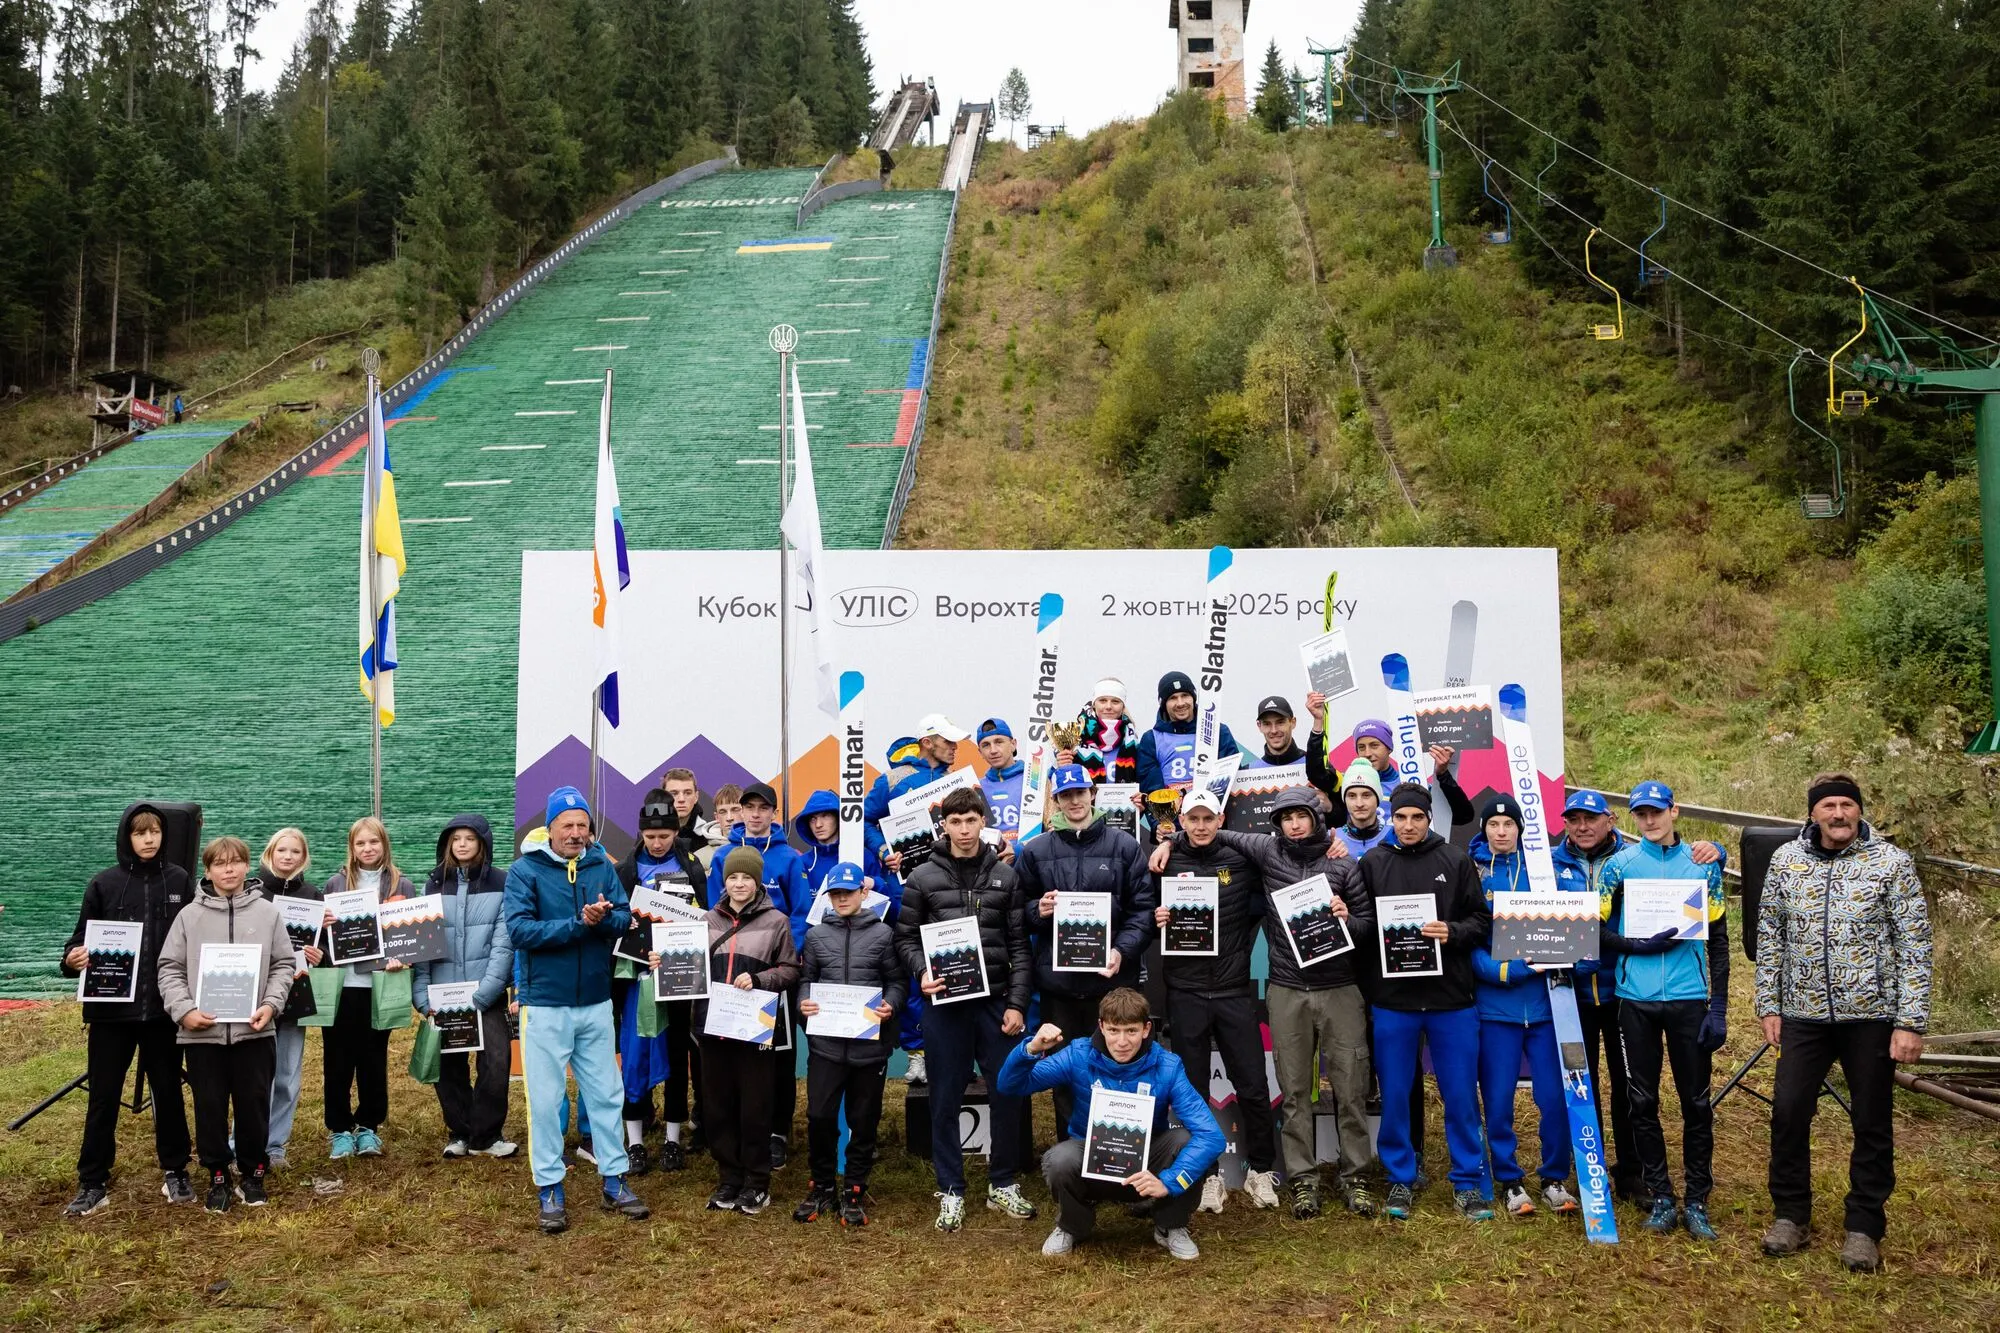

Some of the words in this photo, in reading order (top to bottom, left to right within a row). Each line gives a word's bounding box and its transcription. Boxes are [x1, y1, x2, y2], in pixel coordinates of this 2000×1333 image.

[698, 595, 777, 623] Кубок
[840, 594, 908, 618] УЛІС
[1101, 594, 1116, 617] 2
[1227, 592, 1289, 616] 2025
[1200, 598, 1228, 693] Slatnar
[1028, 647, 1058, 743] Slatnar
[1463, 691, 1477, 699] МРІЇ
[1433, 725, 1448, 733] 000
[1449, 725, 1462, 733] грн
[840, 725, 864, 823] Slatnar
[1236, 774, 1275, 784] СЕРТИФІКАТ
[905, 787, 941, 807] СЕРТИФІКАТ
[941, 782, 951, 792] НА
[950, 776, 964, 788] МРІЇ
[1511, 745, 1543, 852] fluege.de
[990, 804, 1019, 827] 36
[1253, 806, 1262, 814] 15
[1290, 887, 1314, 901] ДИПЛОМ
[340, 897, 363, 906] ДИПЛОМ
[1393, 903, 1420, 911] ДИПЛОМ
[1568, 898, 1584, 906] МРІЇ
[380, 908, 404, 917] ИФІКАТ
[415, 902, 429, 910] МРІЇ
[649, 900, 689, 918] СЕРТИФІКАТ
[689, 912, 699, 921] НА
[938, 928, 962, 937] ДИПЛОМ
[1533, 934, 1550, 942] 000
[388, 940, 403, 948] 000
[404, 938, 417, 946] грн
[1109, 1101, 1136, 1109] ДИПЛОМ
[959, 1106, 984, 1153] 2
[1578, 1125, 1607, 1215] fluege.de
